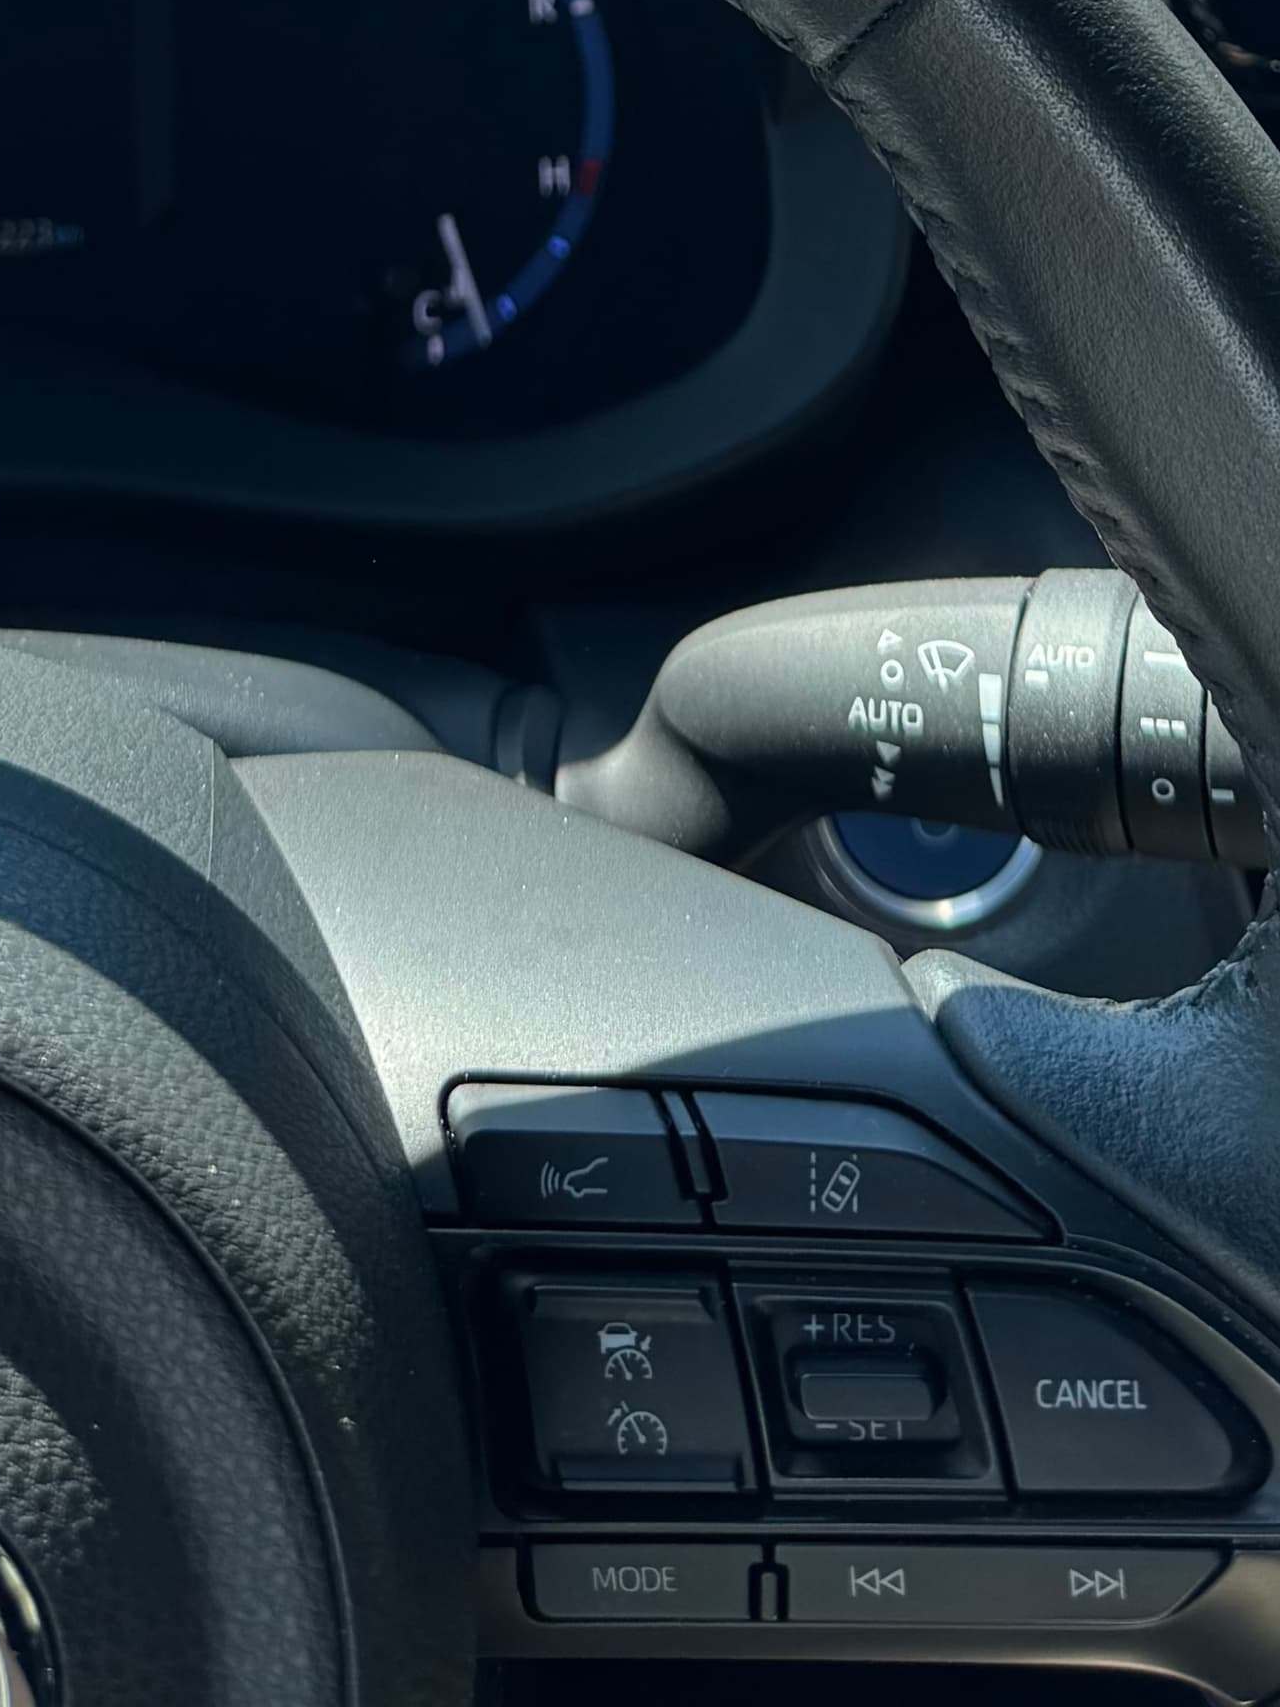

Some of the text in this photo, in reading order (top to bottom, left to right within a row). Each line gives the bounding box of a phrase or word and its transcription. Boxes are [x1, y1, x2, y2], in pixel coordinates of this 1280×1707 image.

[538, 155, 571, 197] H
[412, 289, 443, 335] C
[1026, 643, 1096, 668] AUTO
[848, 696, 922, 733] AUTO
[1035, 1378, 1147, 1410] CANCEL
[592, 1565, 678, 1594] MODE
